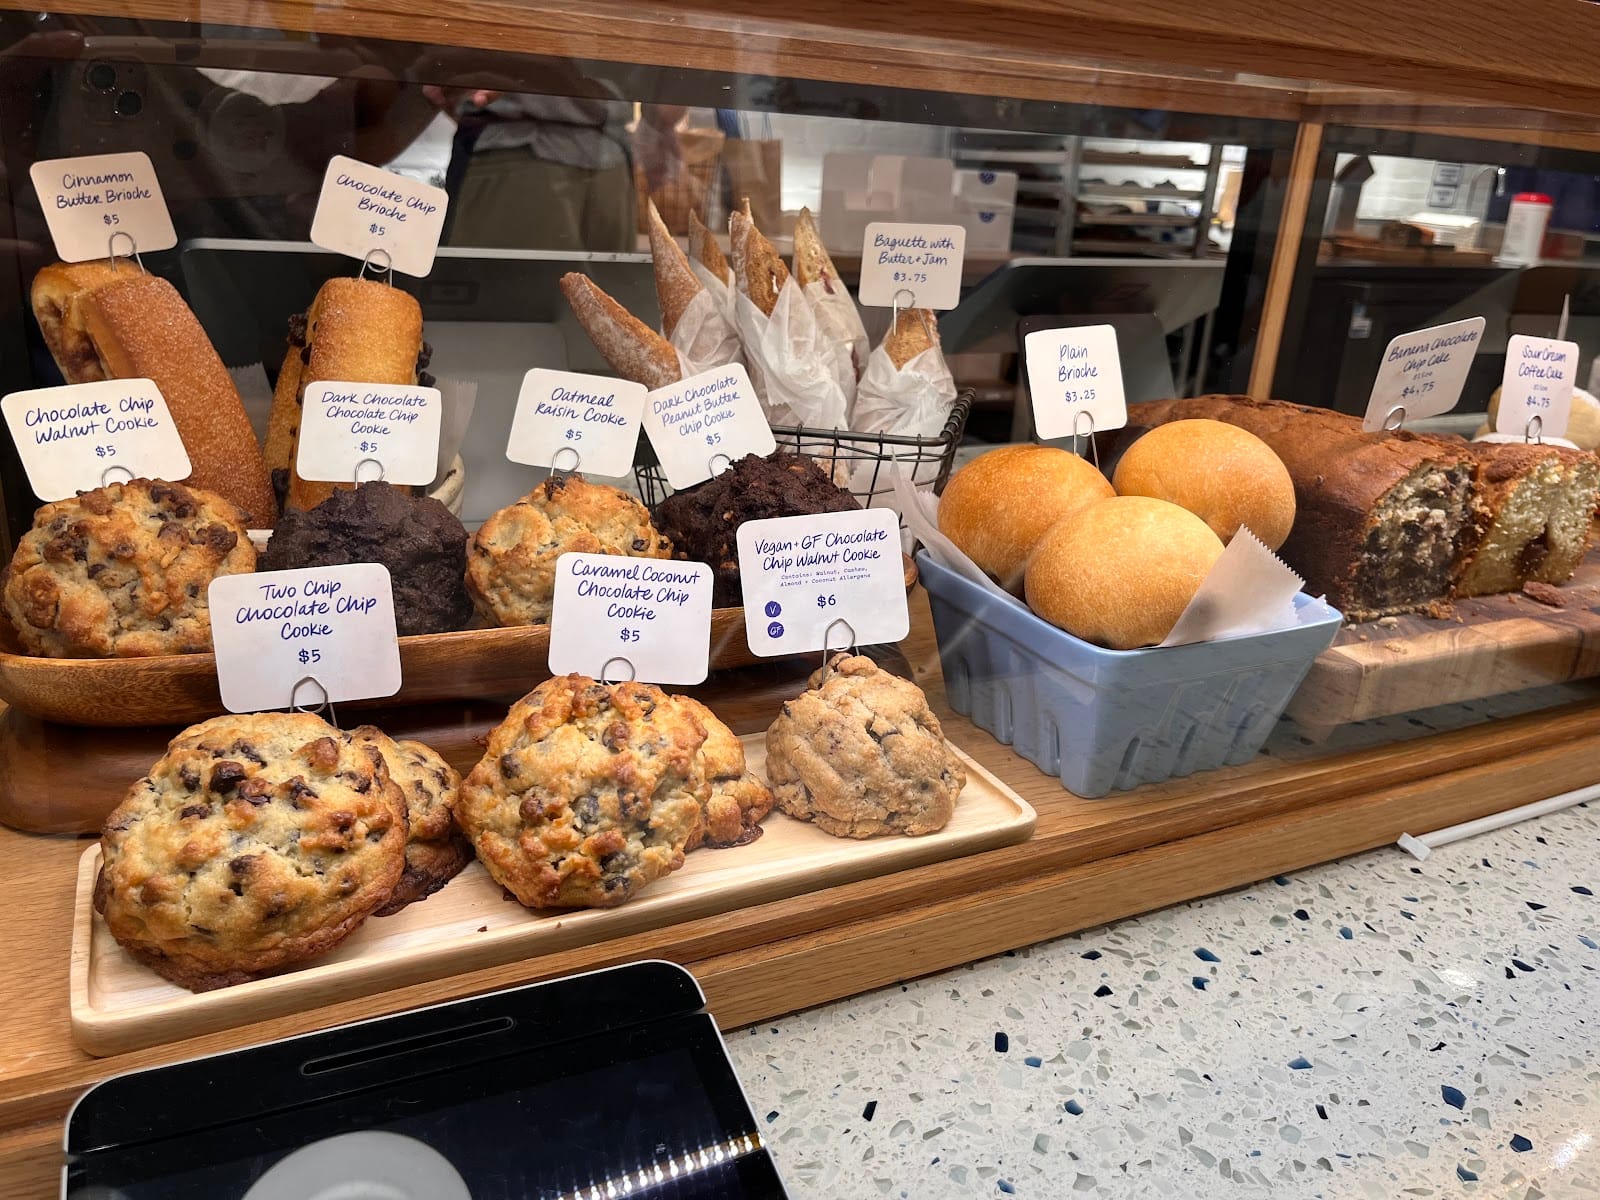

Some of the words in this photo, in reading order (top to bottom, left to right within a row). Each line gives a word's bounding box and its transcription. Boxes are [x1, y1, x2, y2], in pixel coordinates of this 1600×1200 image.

[63, 173, 134, 189] Cinnamon
[57, 192, 103, 209] Butter
[106, 187, 151, 203] Brioche
[337, 174, 402, 202] Chocolate
[407, 197, 436, 215] Chip
[358, 197, 406, 222] Brioche
[104, 214, 119, 225] $5
[369, 223, 386, 236] $5
[874, 234, 927, 251] Baguette
[930, 237, 955, 249] with
[878, 251, 915, 264] Butter
[922, 253, 947, 265] Jam
[894, 272, 927, 282] $3.75
[1060, 344, 1088, 361] Plain
[1388, 343, 1430, 362] Banana
[1431, 330, 1478, 351] Chocolate
[1522, 345, 1541, 358] Sour
[1543, 348, 1566, 361] Cream
[1403, 359, 1426, 373] Chip
[1427, 352, 1451, 366] Cake
[1518, 362, 1544, 378] Coffee
[1546, 366, 1564, 380] Cake
[1058, 362, 1098, 382] Brioche
[322, 392, 359, 404] Dark
[363, 393, 427, 407] Chocolate
[551, 388, 614, 407] Oatmeal
[653, 395, 684, 415] Dark
[685, 376, 738, 402] Chocolate
[1065, 389, 1096, 402] $3.25
[25, 402, 111, 426] Chocolate
[120, 396, 154, 413] Chip
[326, 406, 386, 419] Chocolate
[389, 409, 419, 423] Chip
[535, 402, 580, 419] Raisin
[583, 407, 627, 426] Cookie
[662, 405, 702, 427] Peanut
[704, 391, 740, 411] Butter
[36, 420, 100, 444] Walnut
[106, 417, 159, 433] Cookie
[351, 421, 391, 435] Cookie
[679, 420, 702, 436] Chip
[704, 409, 735, 427] Cookie
[566, 429, 582, 440] $5
[706, 433, 721, 445] $5
[95, 445, 116, 458] $5
[360, 441, 378, 453] $5
[754, 539, 792, 556] Vegan
[801, 534, 823, 550] GF
[825, 528, 888, 547] Chocolate
[763, 557, 793, 572] Chip
[796, 551, 840, 568] Walnut
[843, 548, 880, 563] Cookie
[572, 559, 640, 580] Caramel
[642, 566, 700, 584] Coconut
[260, 584, 297, 600] Two
[303, 579, 341, 598] Chip
[577, 580, 654, 600] Chocolate
[656, 587, 690, 606] Chip
[236, 600, 330, 624] Chocolate
[336, 595, 377, 615] Chip
[817, 594, 836, 608] $6
[607, 603, 656, 620] Cookie
[769, 605, 777, 615] V
[281, 622, 333, 640] Cookie
[620, 627, 640, 642] $5
[769, 625, 783, 636] GF
[298, 648, 321, 664] $5
